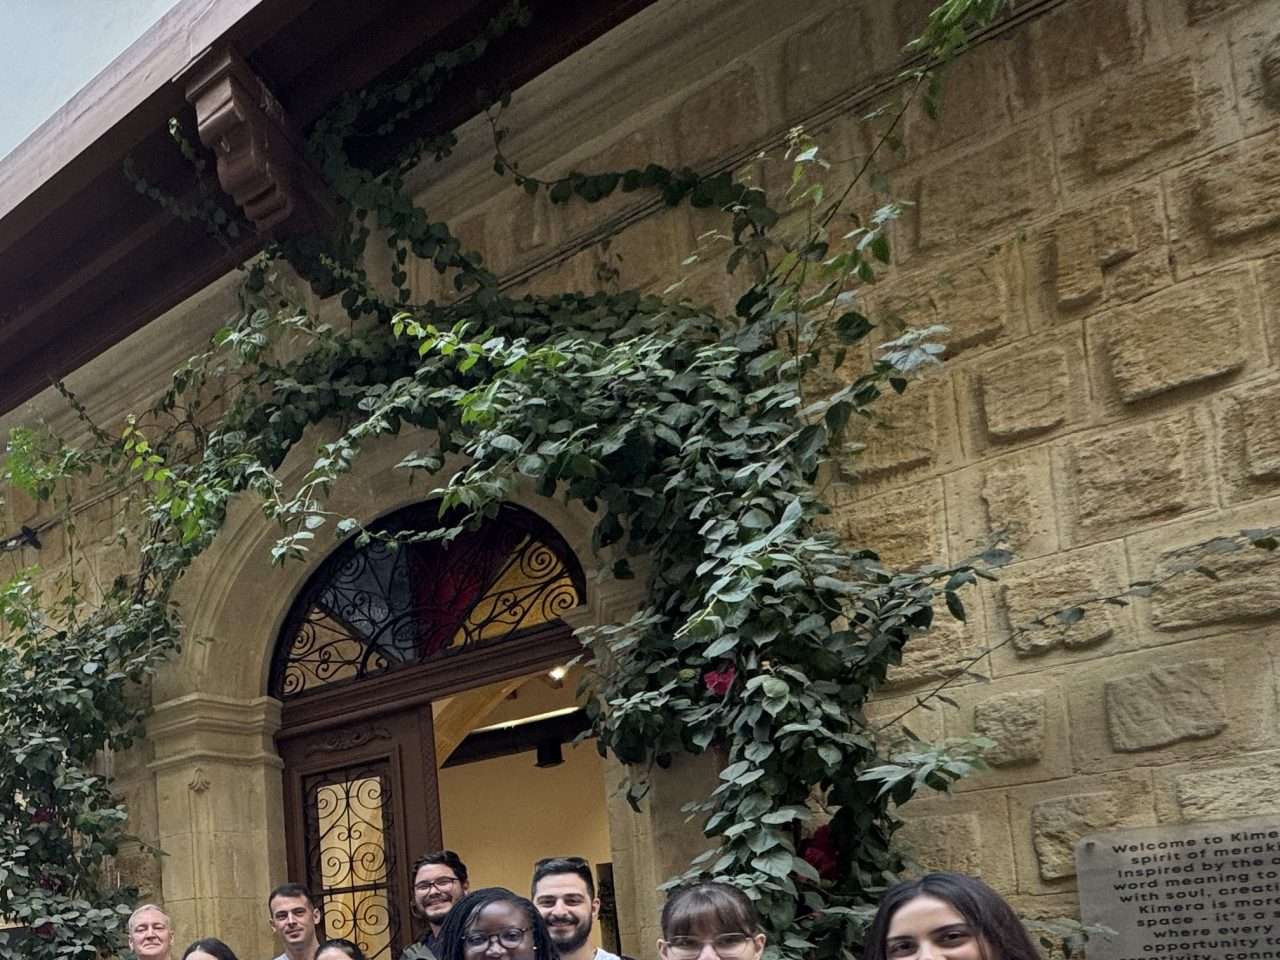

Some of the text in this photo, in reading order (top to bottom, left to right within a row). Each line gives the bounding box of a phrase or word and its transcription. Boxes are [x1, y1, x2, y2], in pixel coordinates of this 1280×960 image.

[1112, 839, 1196, 853] Welcome
[1204, 836, 1223, 845] to
[1131, 853, 1181, 865] spirit
[1187, 849, 1206, 859] of
[1118, 863, 1194, 878] Inspired
[1202, 861, 1224, 872] by
[1232, 858, 1264, 868] the
[1113, 871, 1277, 891] word meaning to
[1120, 892, 1159, 903] with
[1139, 903, 1204, 914] Kimera
[1212, 900, 1227, 909] is
[1137, 917, 1193, 928] space
[1254, 912, 1265, 920] a
[1153, 924, 1273, 938] where every
[1143, 938, 1259, 952] opportunity
